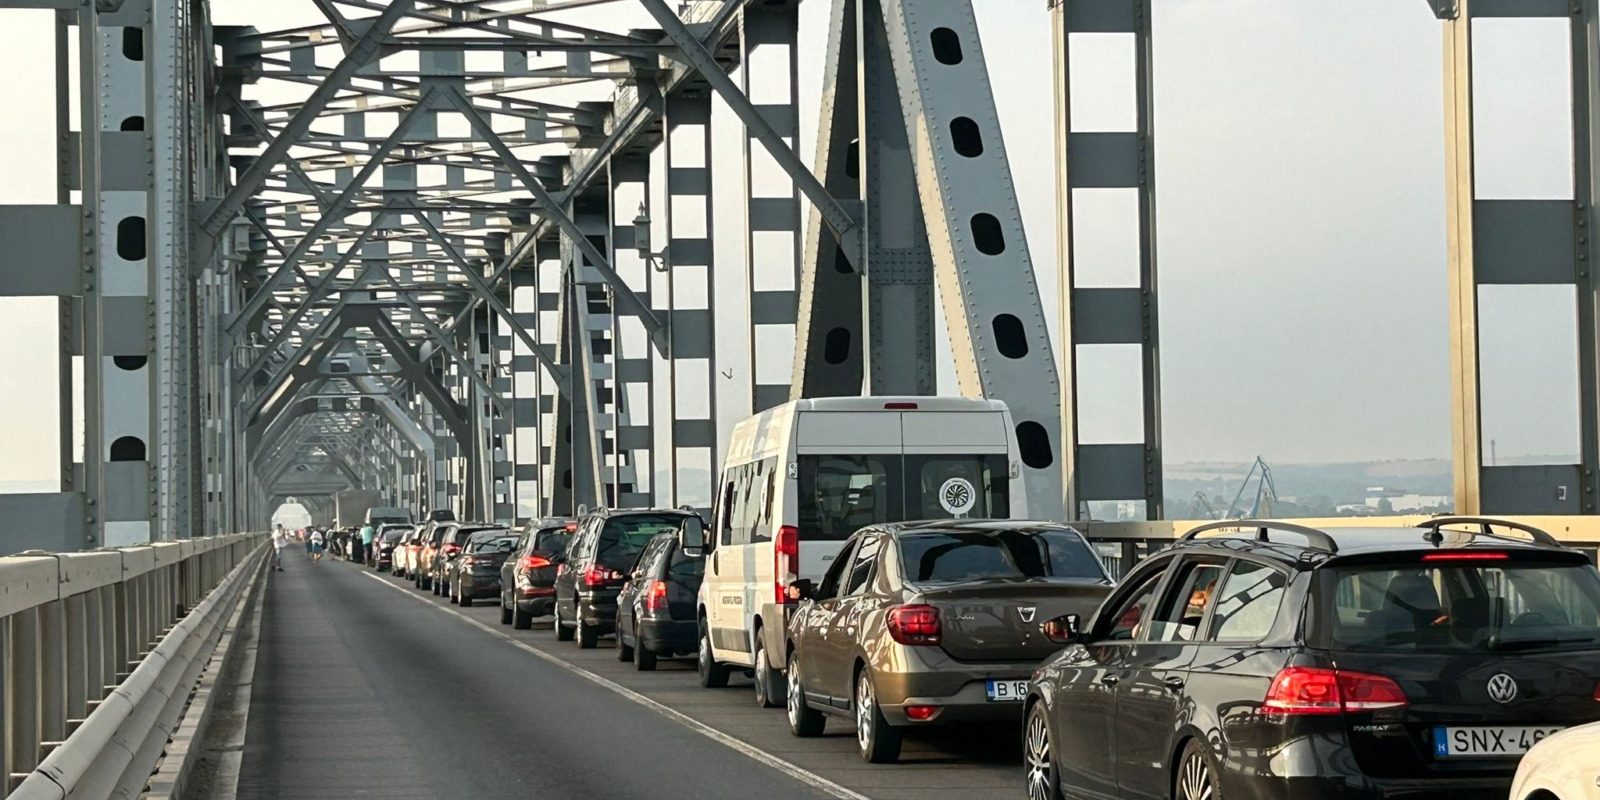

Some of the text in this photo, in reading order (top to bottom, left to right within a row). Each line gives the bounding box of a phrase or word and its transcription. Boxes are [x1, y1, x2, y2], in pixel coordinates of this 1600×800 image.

[997, 682, 1008, 696] B
[1013, 682, 1031, 696] 16
[1454, 729, 1559, 752] SNX-46
[1438, 744, 1446, 752] H
